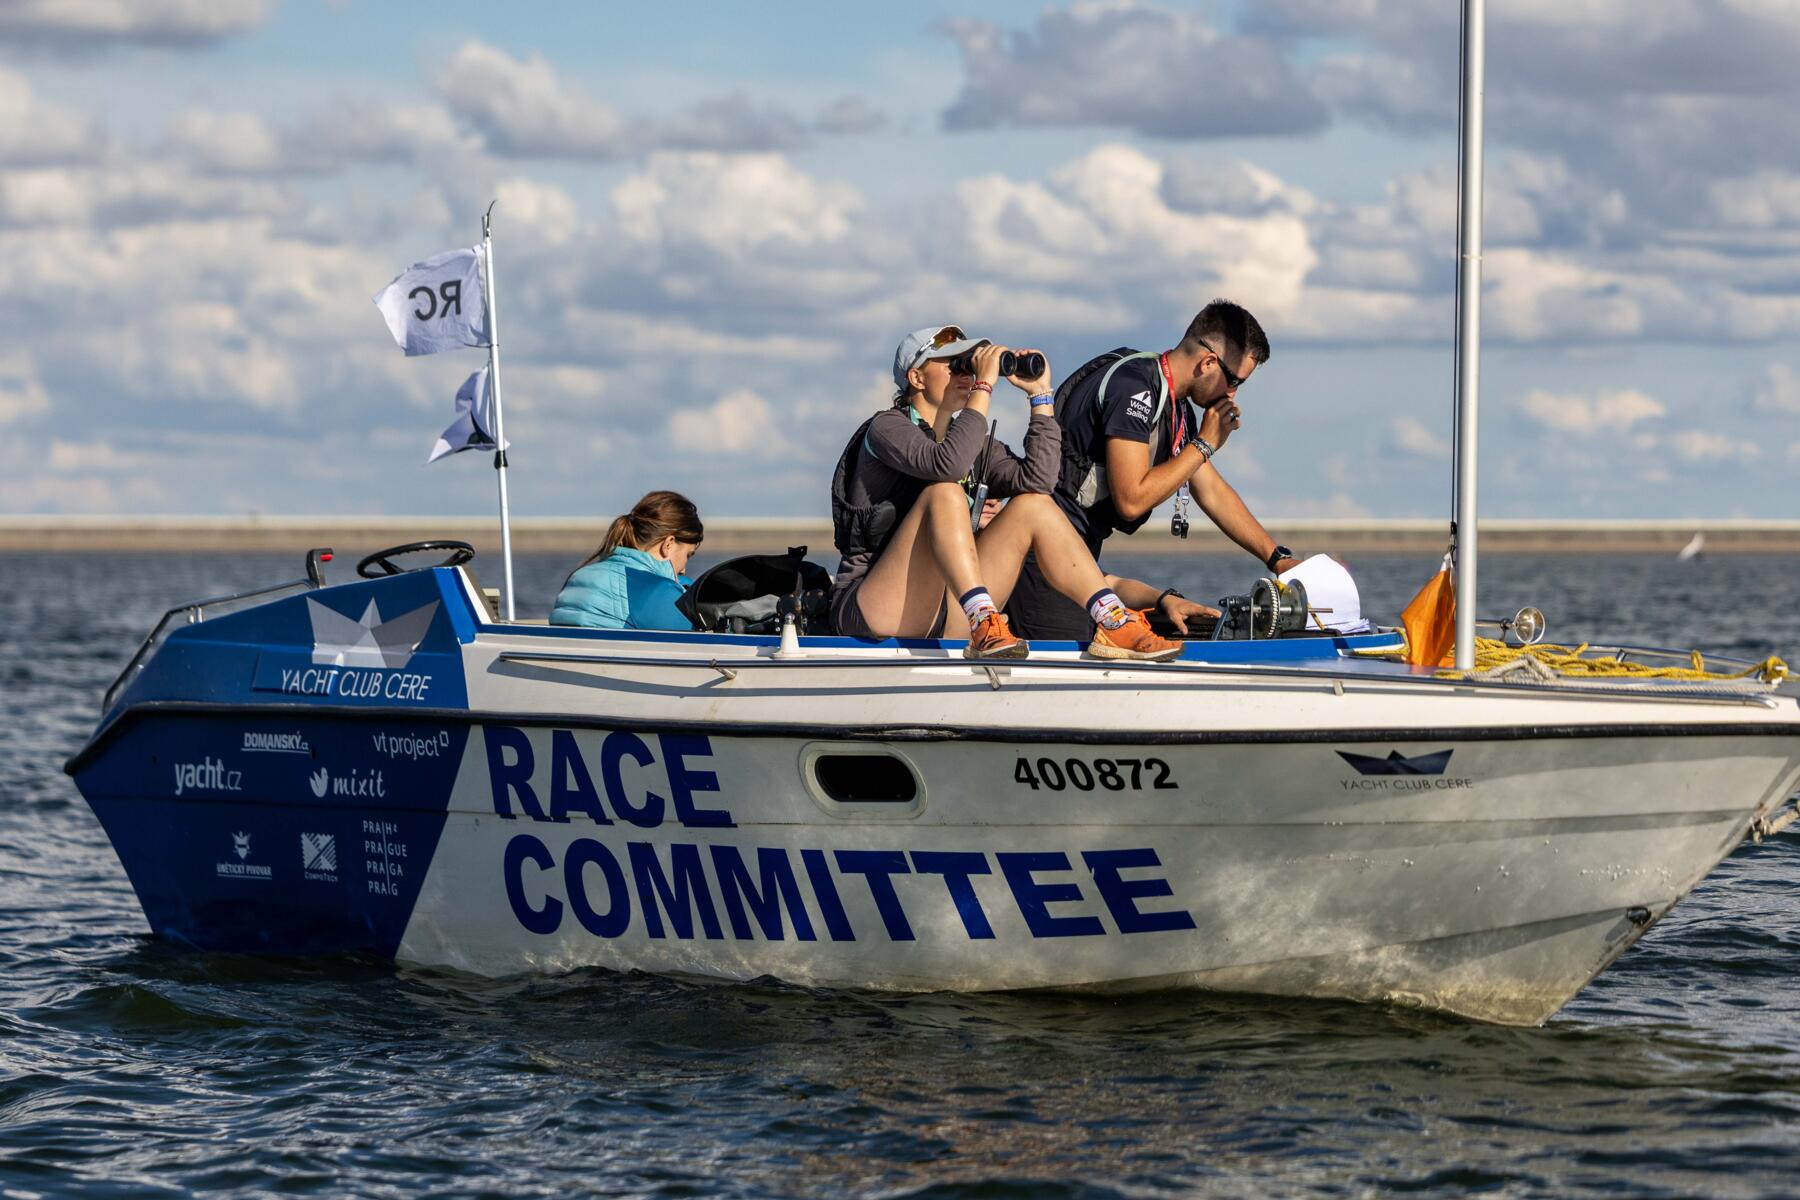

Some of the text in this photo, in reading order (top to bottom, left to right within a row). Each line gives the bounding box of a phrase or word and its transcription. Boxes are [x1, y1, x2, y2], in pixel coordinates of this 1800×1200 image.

[1126, 407, 1149, 423] Sailing
[1130, 399, 1150, 414] World
[281, 669, 432, 700] YACHT CLUB CERE
[373, 732, 440, 760] vt project
[174, 756, 242, 796] yacht.cz
[333, 768, 386, 798] mixit
[482, 724, 738, 828] RACE
[1013, 757, 1179, 792] 400872
[1340, 778, 1474, 790] YACHT CLUB CERE
[503, 833, 1198, 942] COMMITTEE
